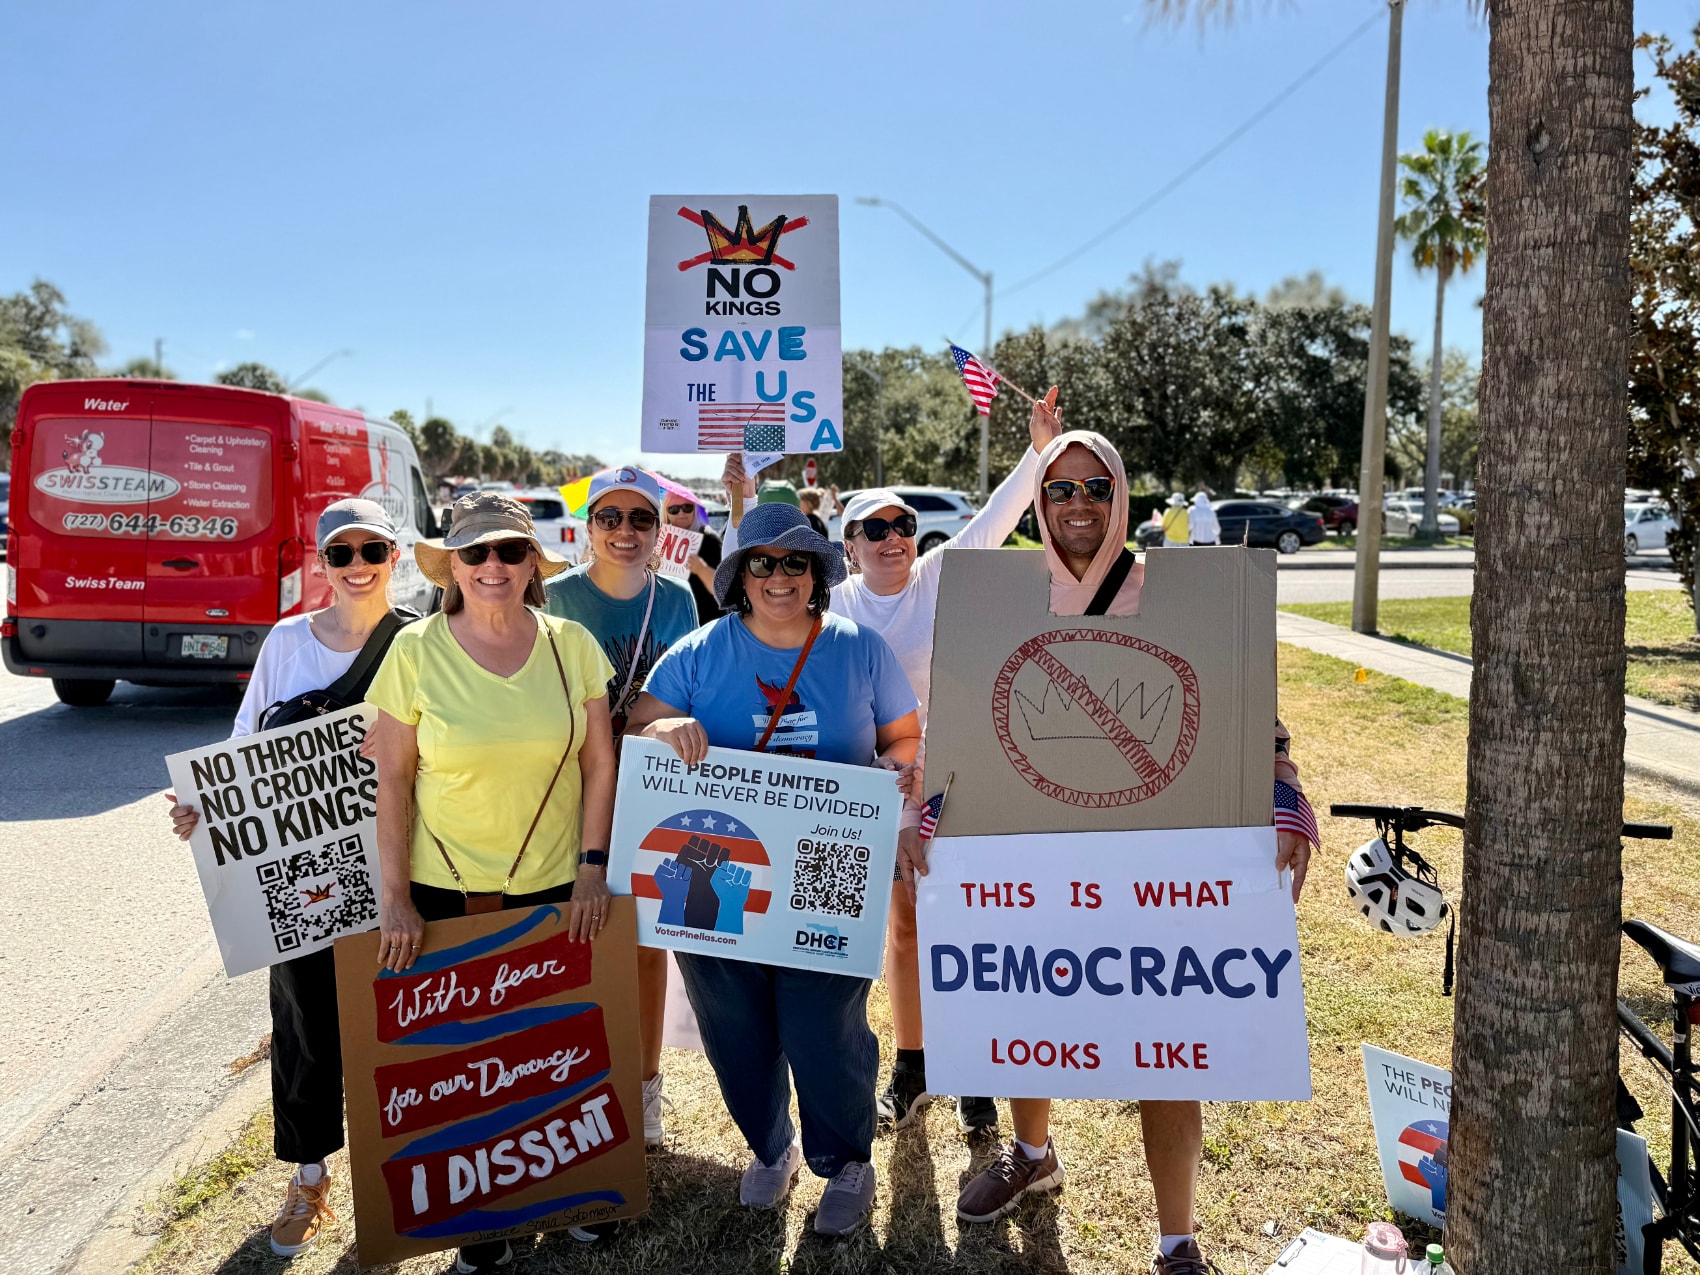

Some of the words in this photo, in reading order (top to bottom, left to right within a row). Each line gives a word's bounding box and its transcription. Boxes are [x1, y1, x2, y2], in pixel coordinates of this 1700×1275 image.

[706, 268, 781, 299] NO
[705, 301, 781, 316] KINGS
[680, 326, 807, 362] SAVE
[83, 398, 129, 412] Water
[687, 383, 717, 402] THE
[189, 434, 216, 445] Carpet
[189, 444, 223, 456] Cleaning
[189, 461, 203, 471] Tile
[212, 463, 234, 472] Grout
[188, 480, 211, 490] Stone
[212, 481, 247, 493] Cleaning
[188, 498, 211, 508] Water
[212, 499, 250, 510] Extraction
[63, 513, 105, 530] (727)
[109, 513, 238, 537] 644-6346
[661, 533, 690, 564] NO
[190, 752, 237, 791] NO
[237, 714, 367, 777] THRONES
[200, 785, 246, 824] NO
[251, 749, 376, 809] CROWNS
[644, 755, 682, 774] THE
[686, 762, 763, 785] PEOPLE
[768, 772, 840, 795] UNITED
[642, 775, 689, 795] WILL
[694, 781, 759, 804] NEVER
[763, 791, 789, 808] BE
[794, 794, 880, 820] DIVIDED!
[208, 815, 268, 866] NO
[272, 778, 379, 847] KINGS
[810, 823, 838, 838] Join
[841, 827, 863, 840] Us!
[960, 882, 1036, 908] THIS
[1070, 881, 1102, 910] IS
[1133, 880, 1233, 908] WHAT
[655, 926, 737, 945] VotarPinellas.com
[795, 930, 849, 951] DHCF
[930, 943, 1293, 999] DEMOCRACY
[389, 970, 481, 1028] With
[490, 959, 566, 1006] fear
[991, 1038, 1101, 1070] LOOKS
[1135, 1042, 1209, 1070] LIKE
[1381, 1063, 1417, 1087] THE
[1420, 1076, 1452, 1099] PEO
[1384, 1079, 1429, 1106] WILL
[382, 1087, 424, 1127] for
[429, 1074, 474, 1102] our
[411, 1163, 430, 1215] I
[449, 1093, 611, 1205] DISSENT
